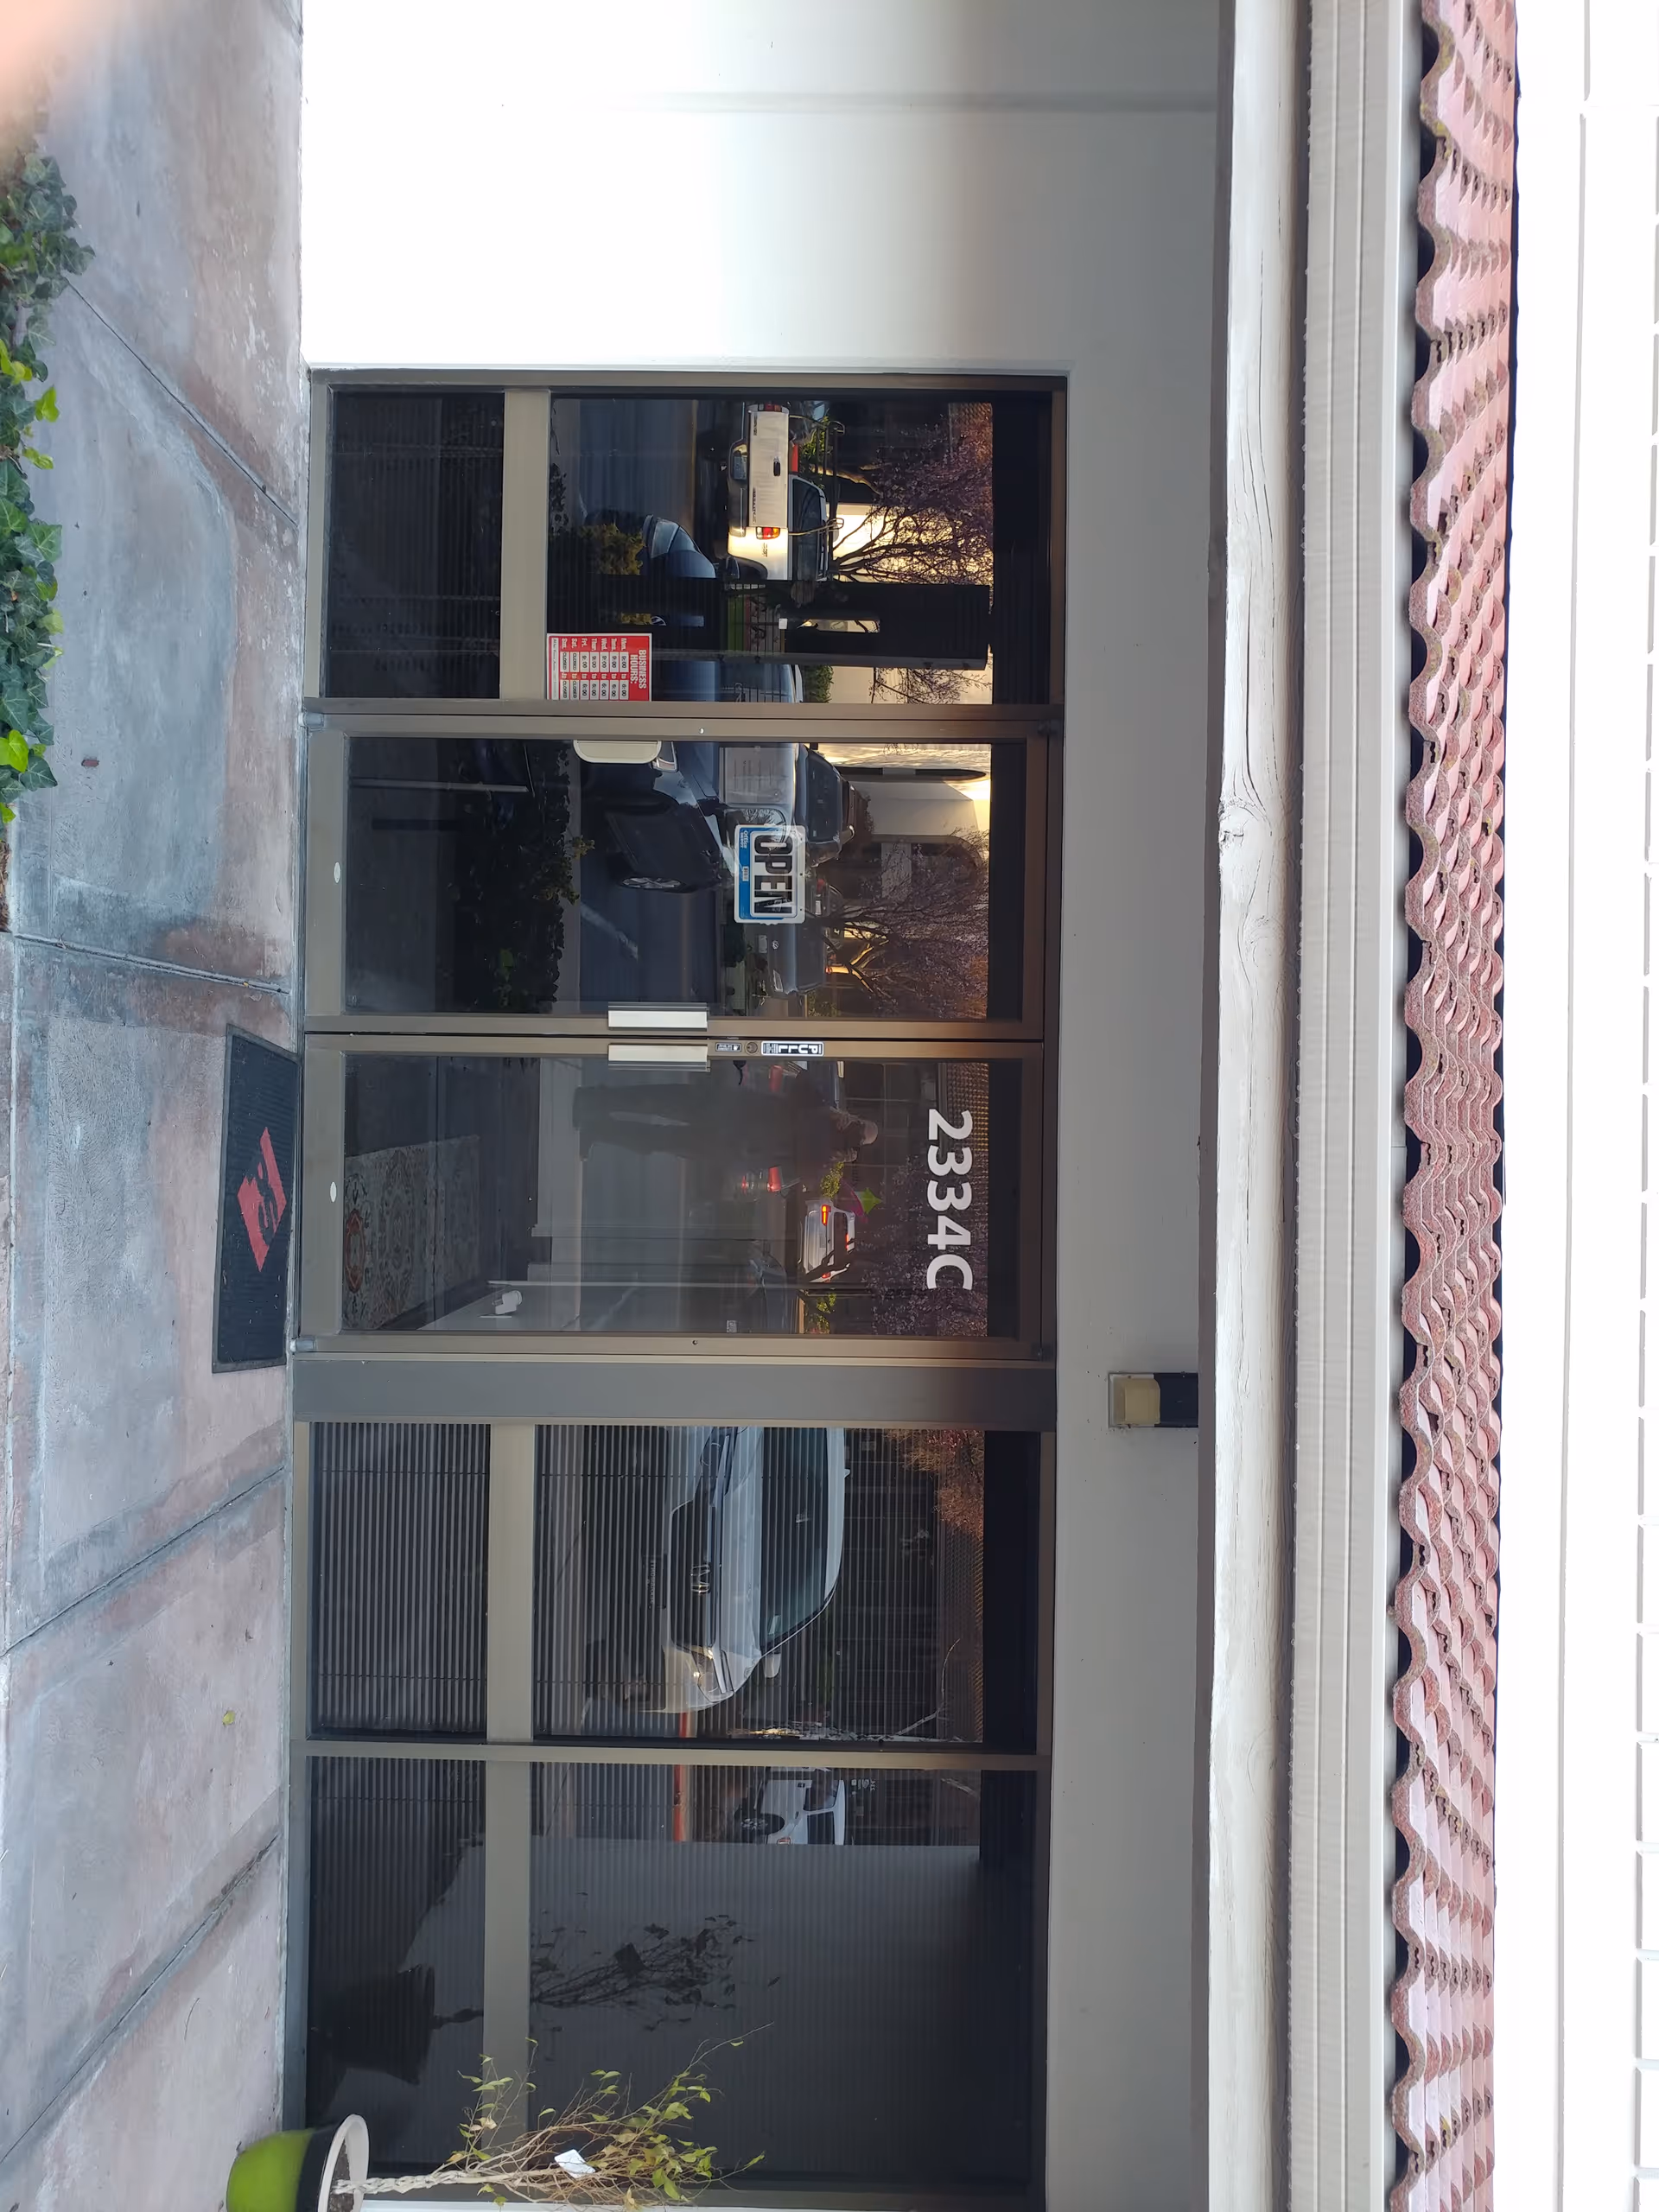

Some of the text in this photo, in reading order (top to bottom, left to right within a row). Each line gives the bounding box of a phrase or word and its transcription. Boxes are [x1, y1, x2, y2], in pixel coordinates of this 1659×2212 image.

[754, 835, 793, 913] OPEN
[778, 1044, 818, 1054] PULL
[926, 1109, 973, 1290] 2334C
